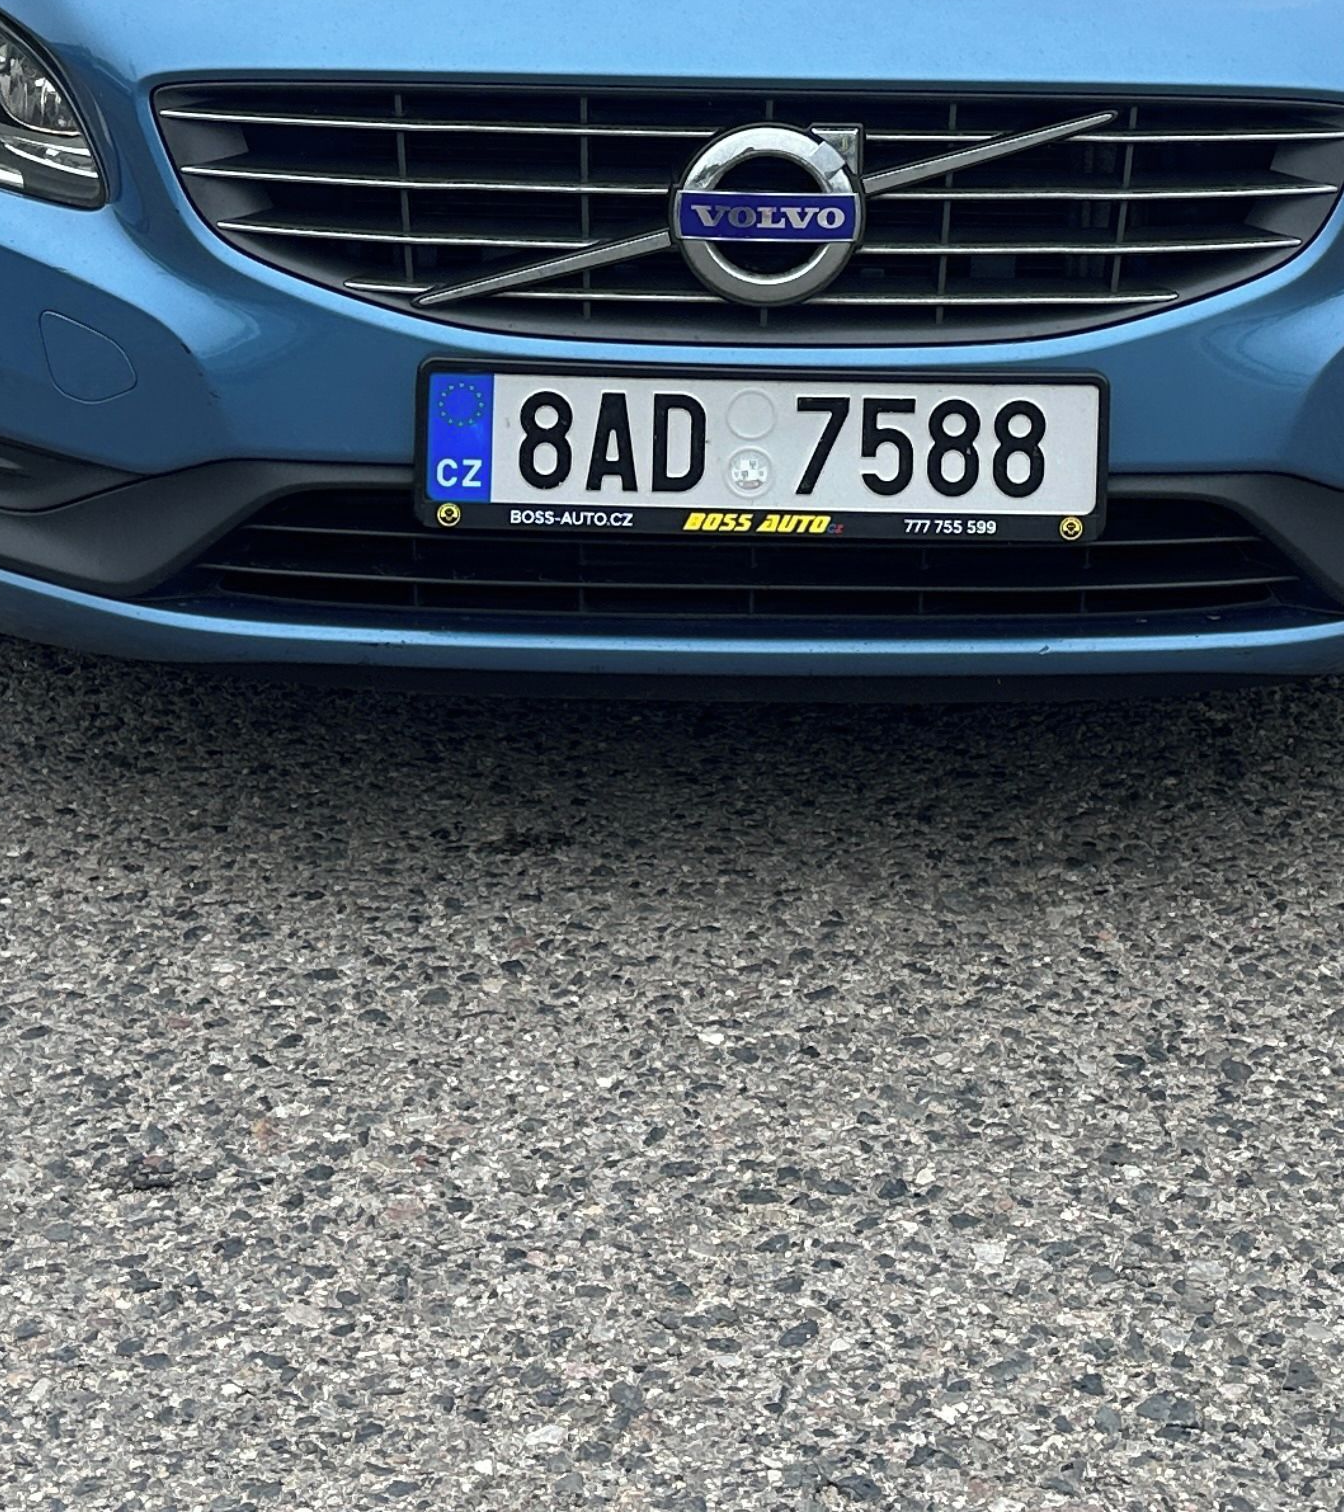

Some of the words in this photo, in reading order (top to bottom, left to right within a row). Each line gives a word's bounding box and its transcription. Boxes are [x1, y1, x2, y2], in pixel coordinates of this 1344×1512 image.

[690, 204, 846, 229] VOLVO
[517, 390, 707, 494] 8AD
[794, 396, 1047, 499] 7588
[436, 458, 483, 489] CZ
[509, 510, 633, 527] BOSS-AUTO.CZ
[683, 512, 753, 533] BOSS
[756, 513, 832, 534] AUTO
[904, 519, 931, 533] 777
[934, 519, 962, 534] 755
[966, 520, 997, 534] 599
